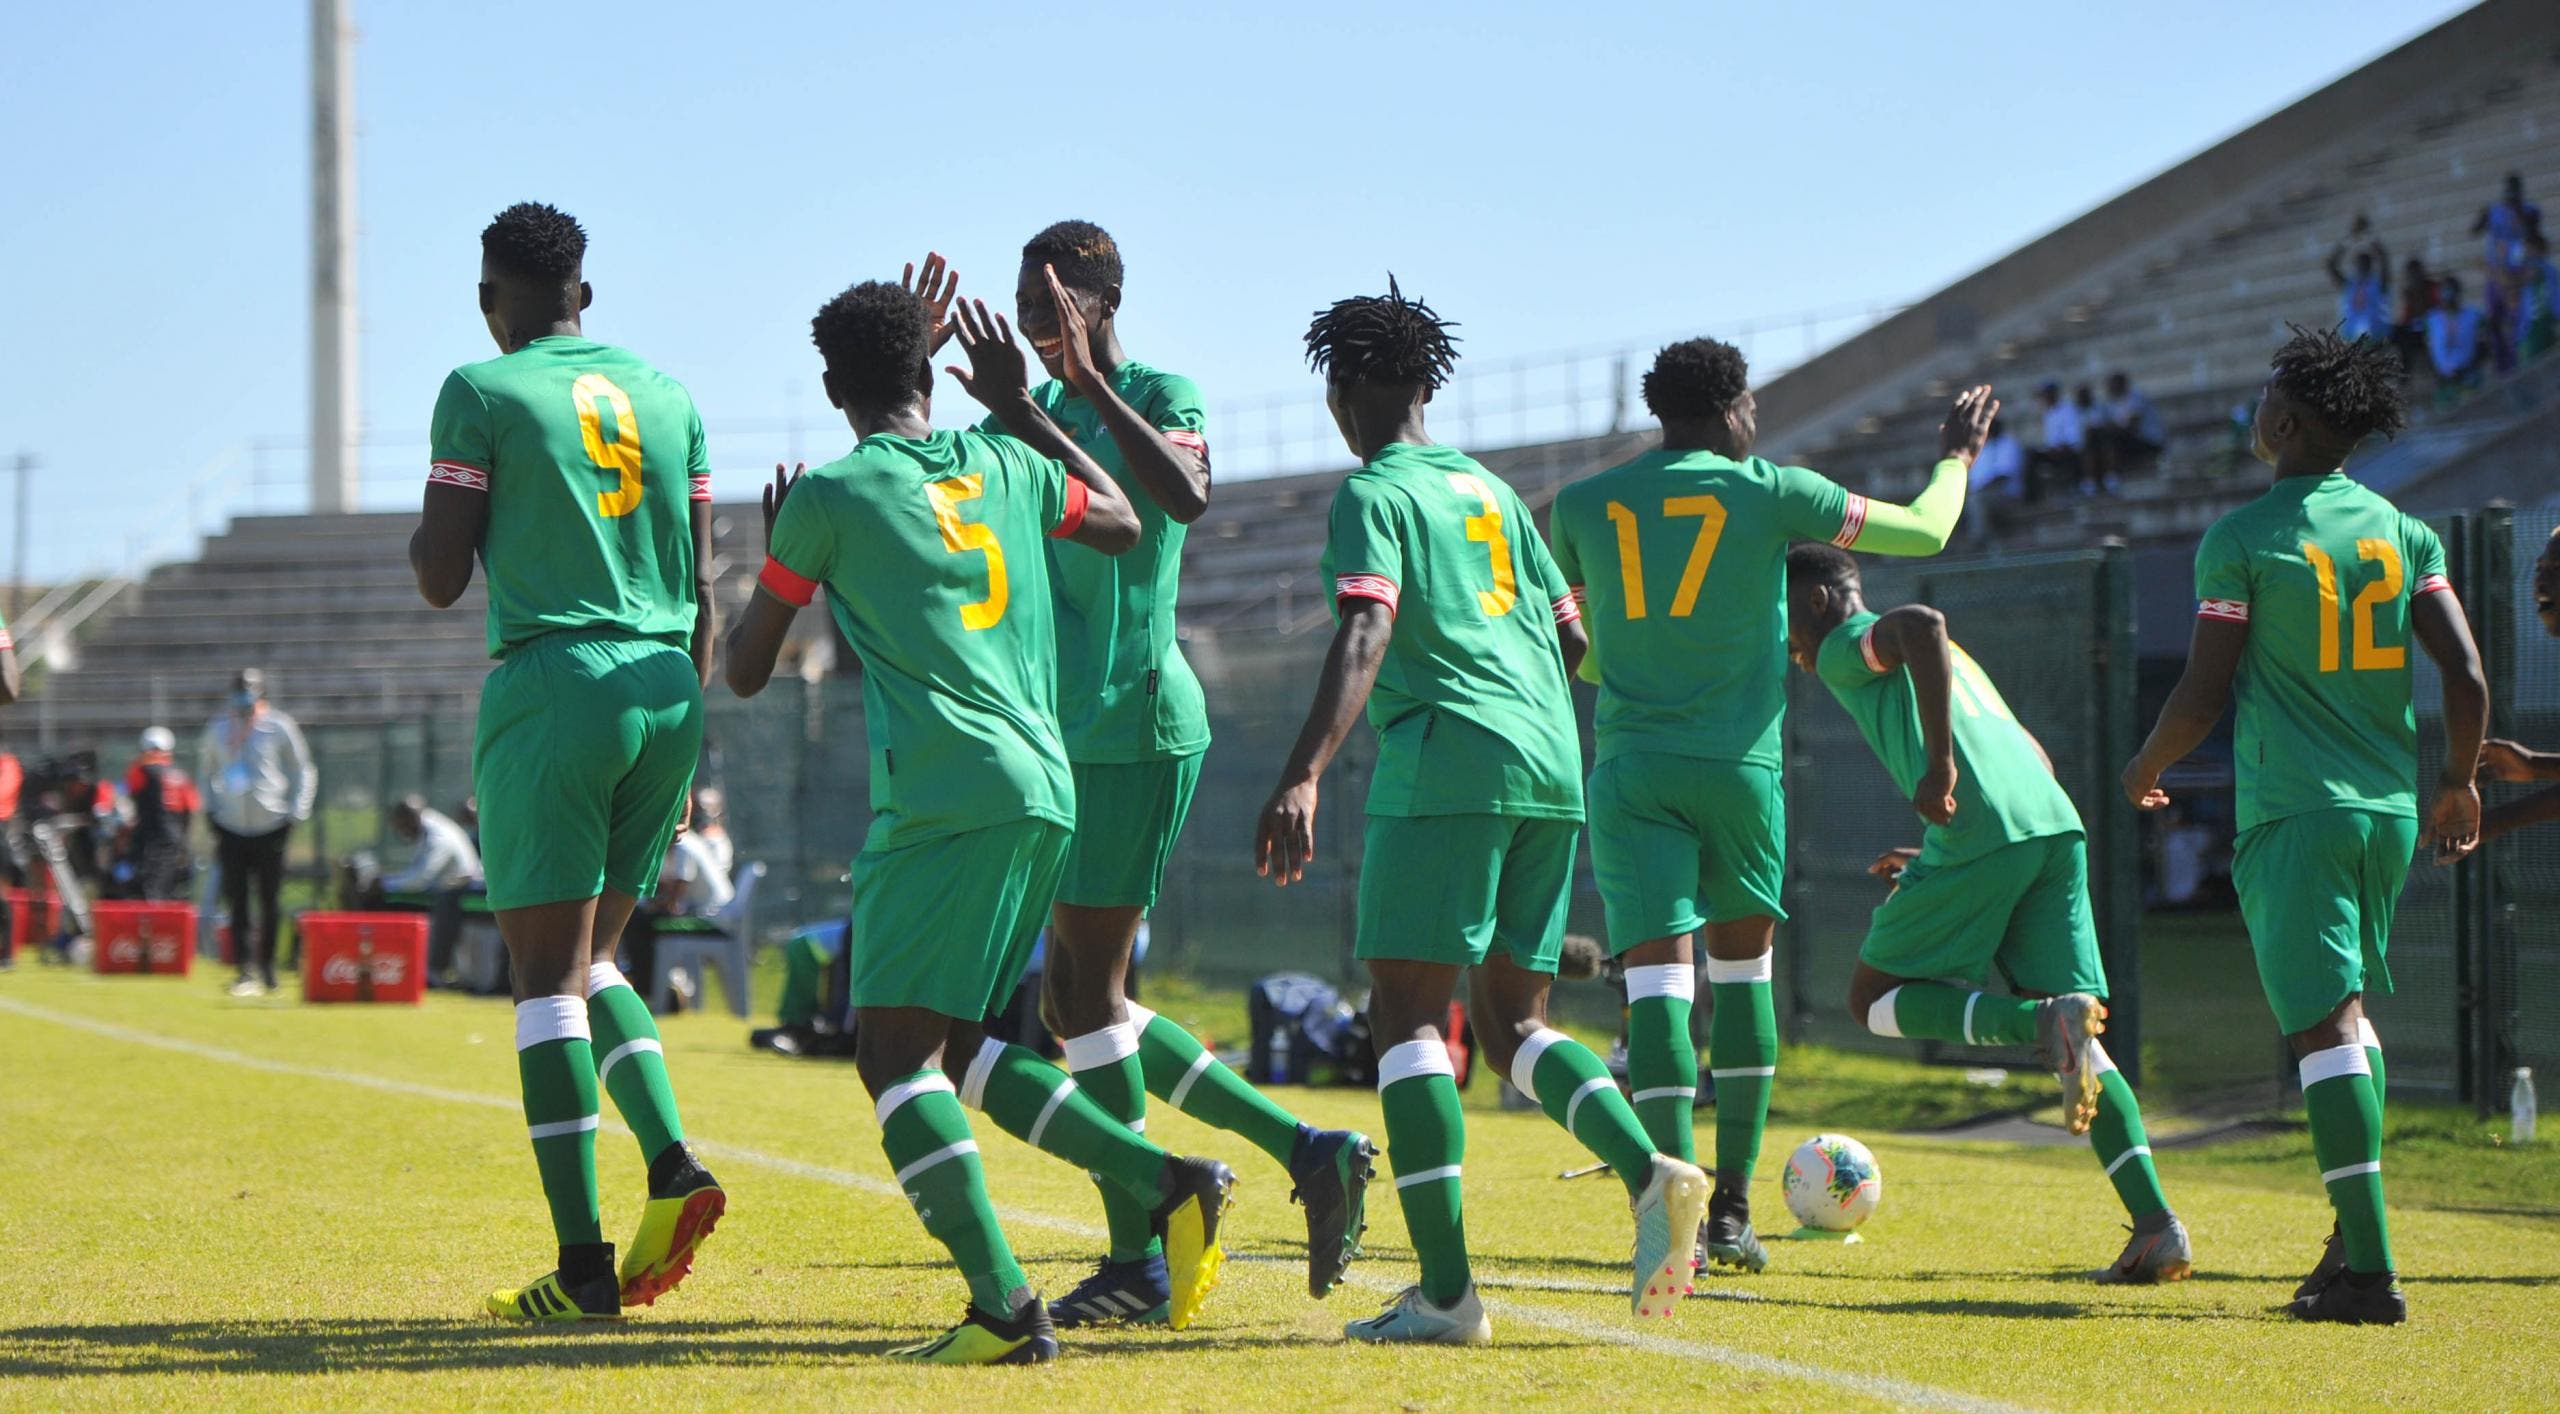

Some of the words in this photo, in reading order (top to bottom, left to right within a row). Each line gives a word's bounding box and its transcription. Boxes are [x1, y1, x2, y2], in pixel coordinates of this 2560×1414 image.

[573, 374, 644, 518] 9
[925, 473, 1009, 630] 5
[1446, 473, 1517, 616] 3
[1607, 495, 1727, 619] 17
[2304, 538, 2405, 672] 12
